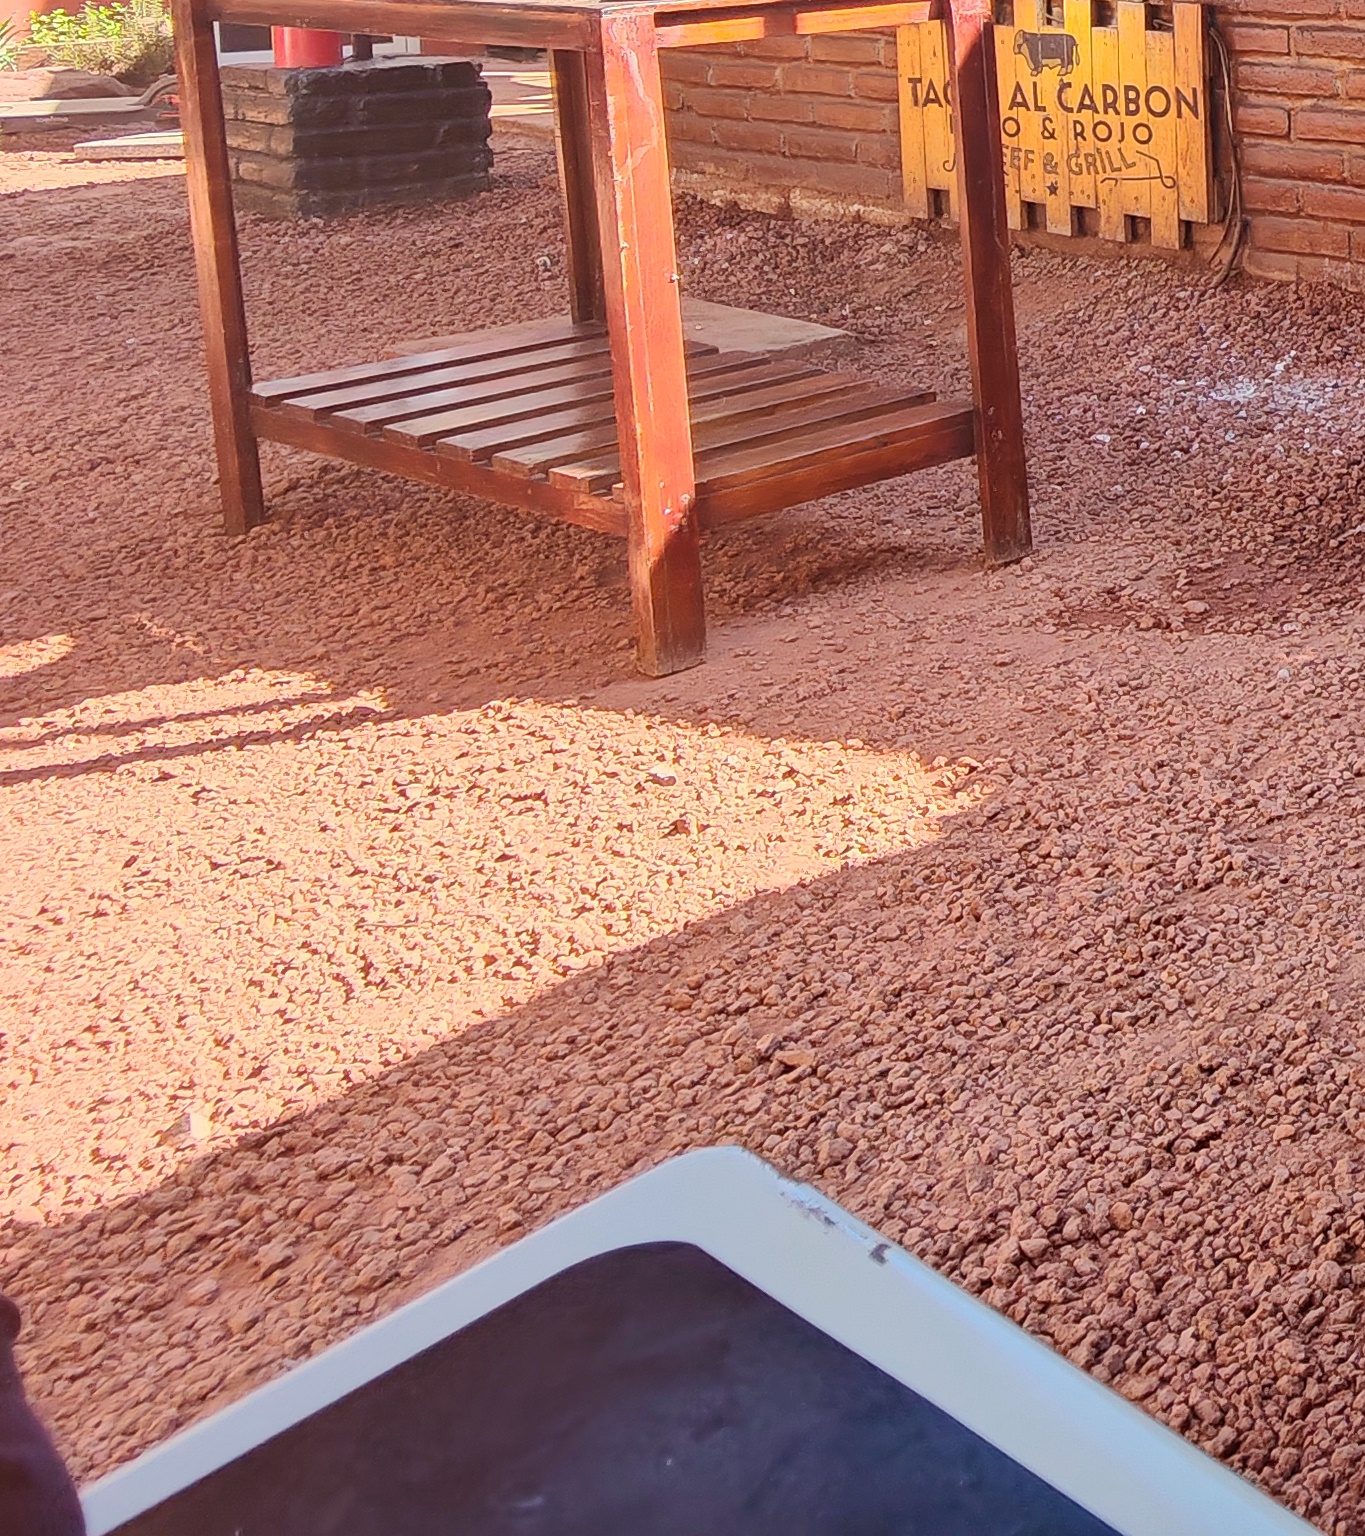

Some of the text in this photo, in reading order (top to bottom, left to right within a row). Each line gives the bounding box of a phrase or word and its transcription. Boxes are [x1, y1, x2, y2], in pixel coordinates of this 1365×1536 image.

[907, 77, 1200, 120] TAC AL CARBON
[1041, 116, 1058, 141] &
[1073, 119, 1153, 145] ROJO
[1043, 151, 1060, 175] &
[1066, 147, 1137, 175] GRILL
